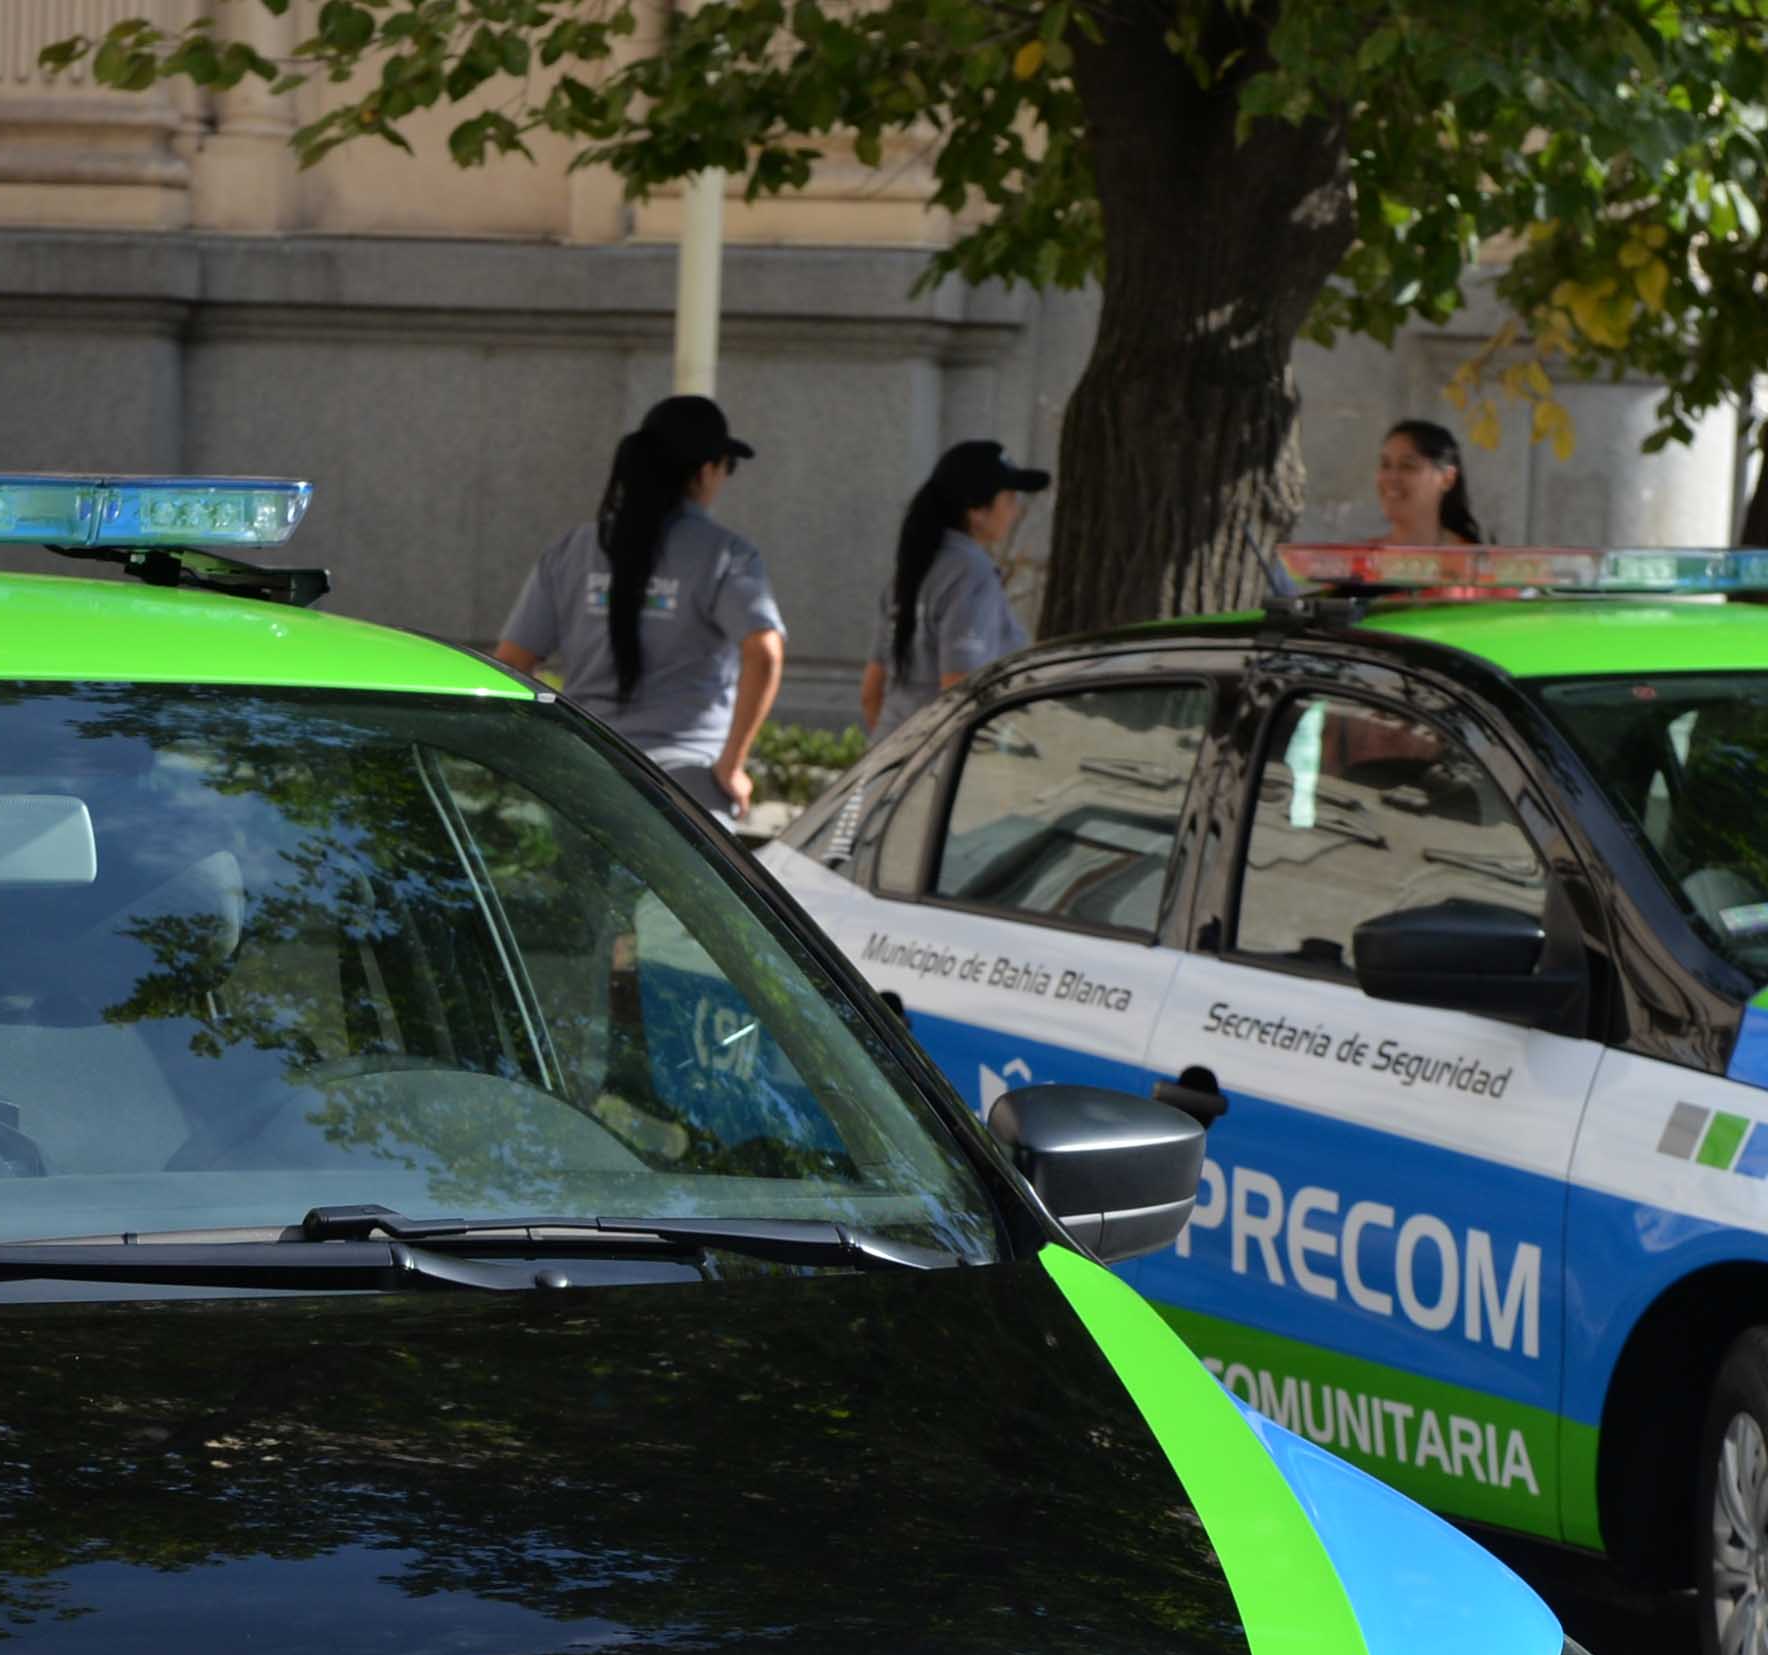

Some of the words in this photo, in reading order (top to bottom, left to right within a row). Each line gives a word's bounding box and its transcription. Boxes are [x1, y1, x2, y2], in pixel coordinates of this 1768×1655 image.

[861, 932, 954, 981] Municipio
[959, 952, 983, 983] de
[987, 958, 1052, 995] Bahía
[1054, 970, 1133, 1012] Blanca
[1202, 1002, 1331, 1058] Secretaría
[1336, 1033, 1370, 1066] de
[1372, 1040, 1513, 1100] Seguridad
[1175, 1157, 1542, 1359] PRECOM
